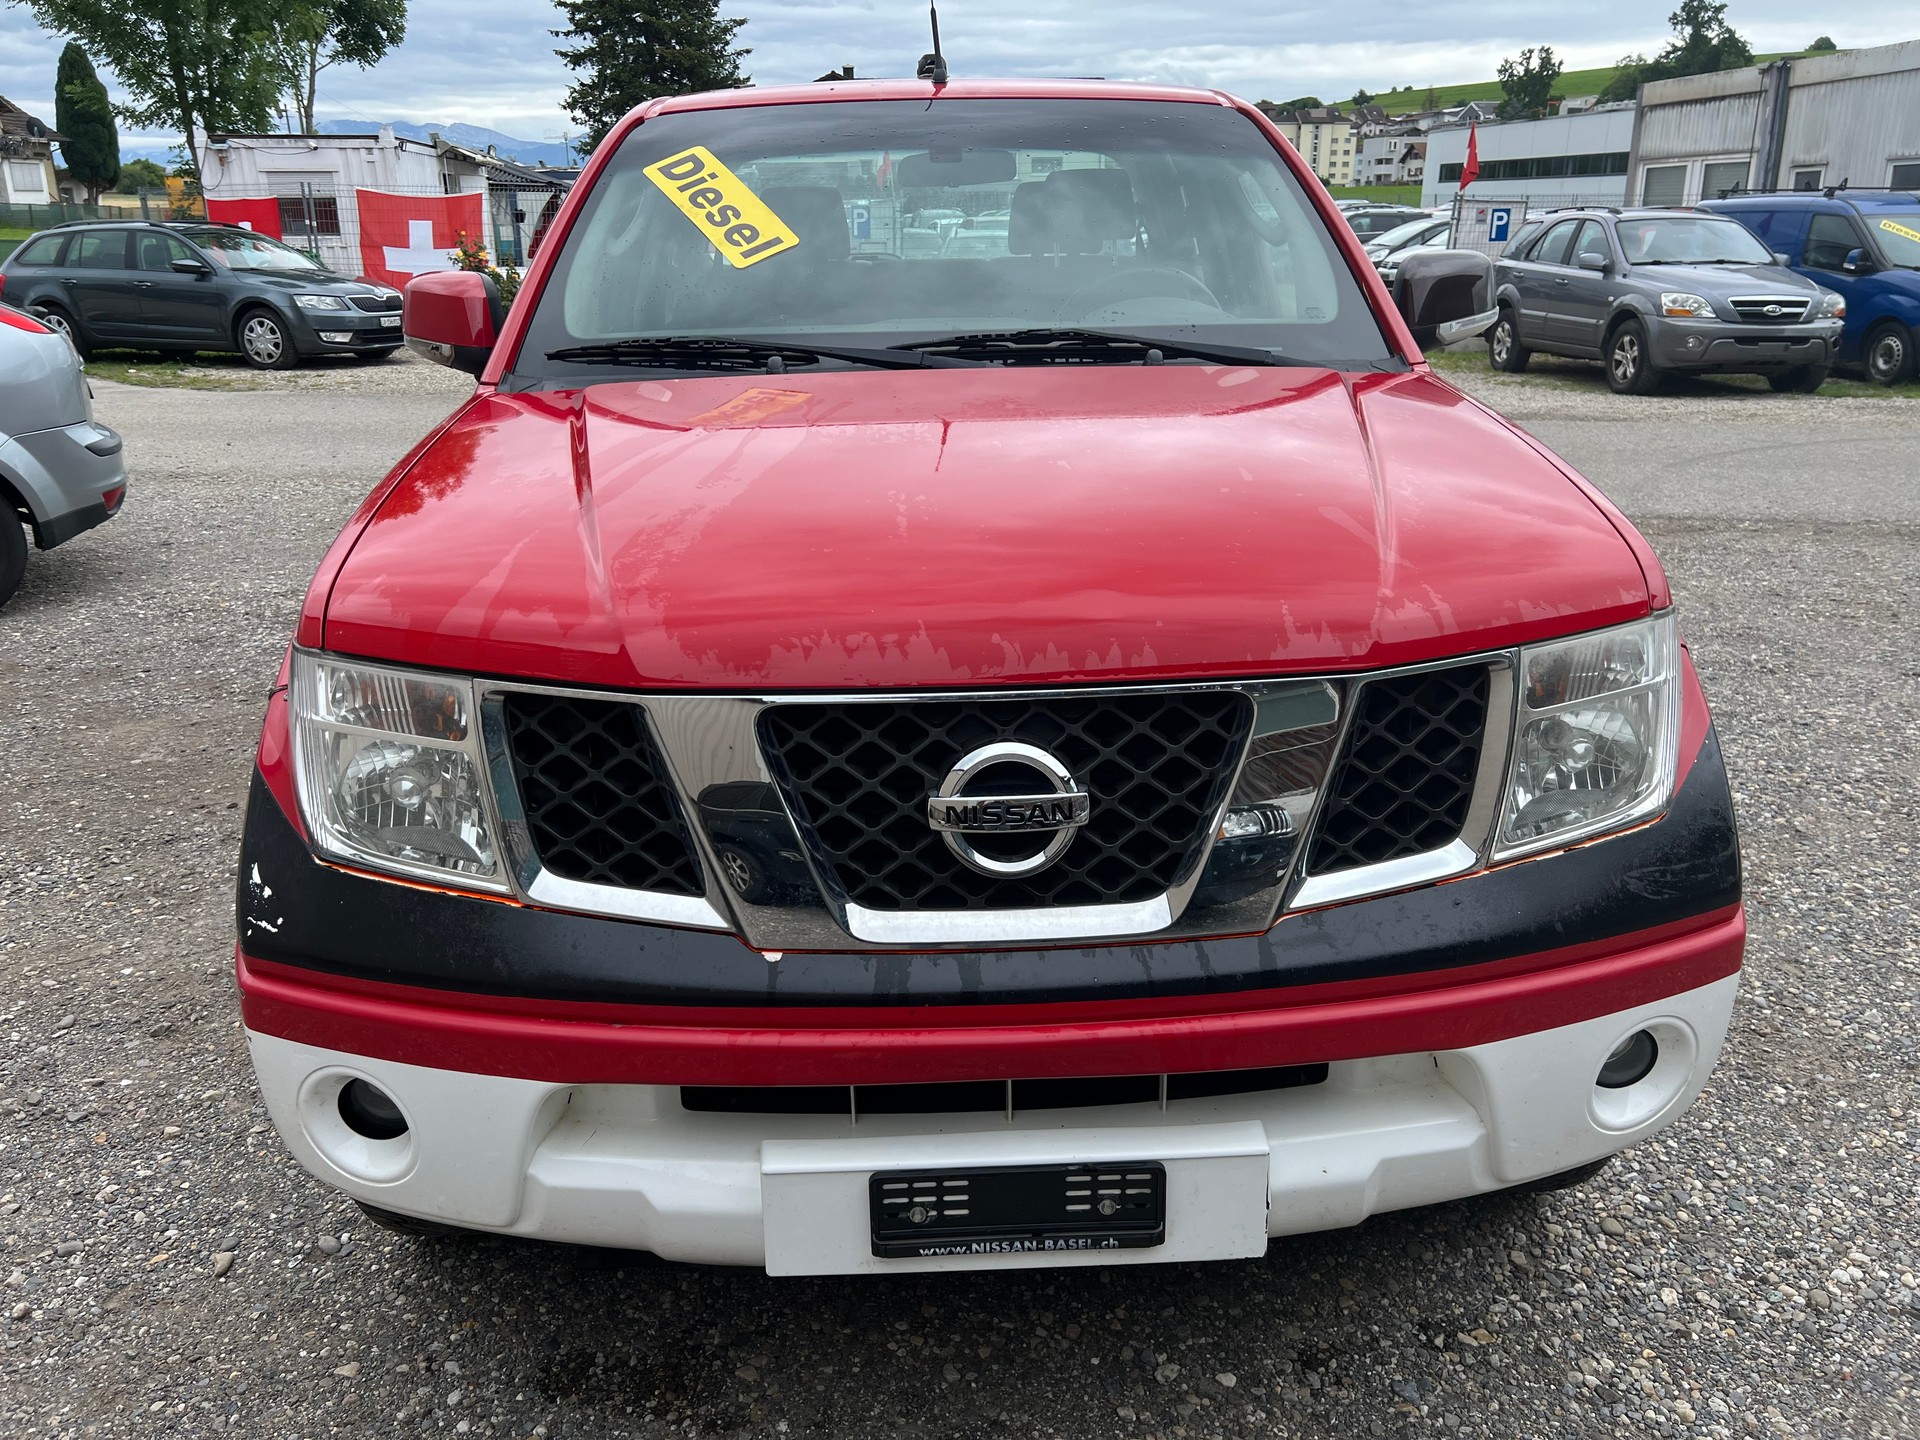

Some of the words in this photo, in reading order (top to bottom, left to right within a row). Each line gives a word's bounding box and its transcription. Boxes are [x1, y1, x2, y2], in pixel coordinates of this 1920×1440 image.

[656, 153, 785, 260] Diesel
[853, 208, 869, 236] P
[1491, 211, 1508, 239] P
[945, 802, 1074, 826] NISSAN
[919, 1237, 1120, 1257] www.NISSAN-BASEL.ch
